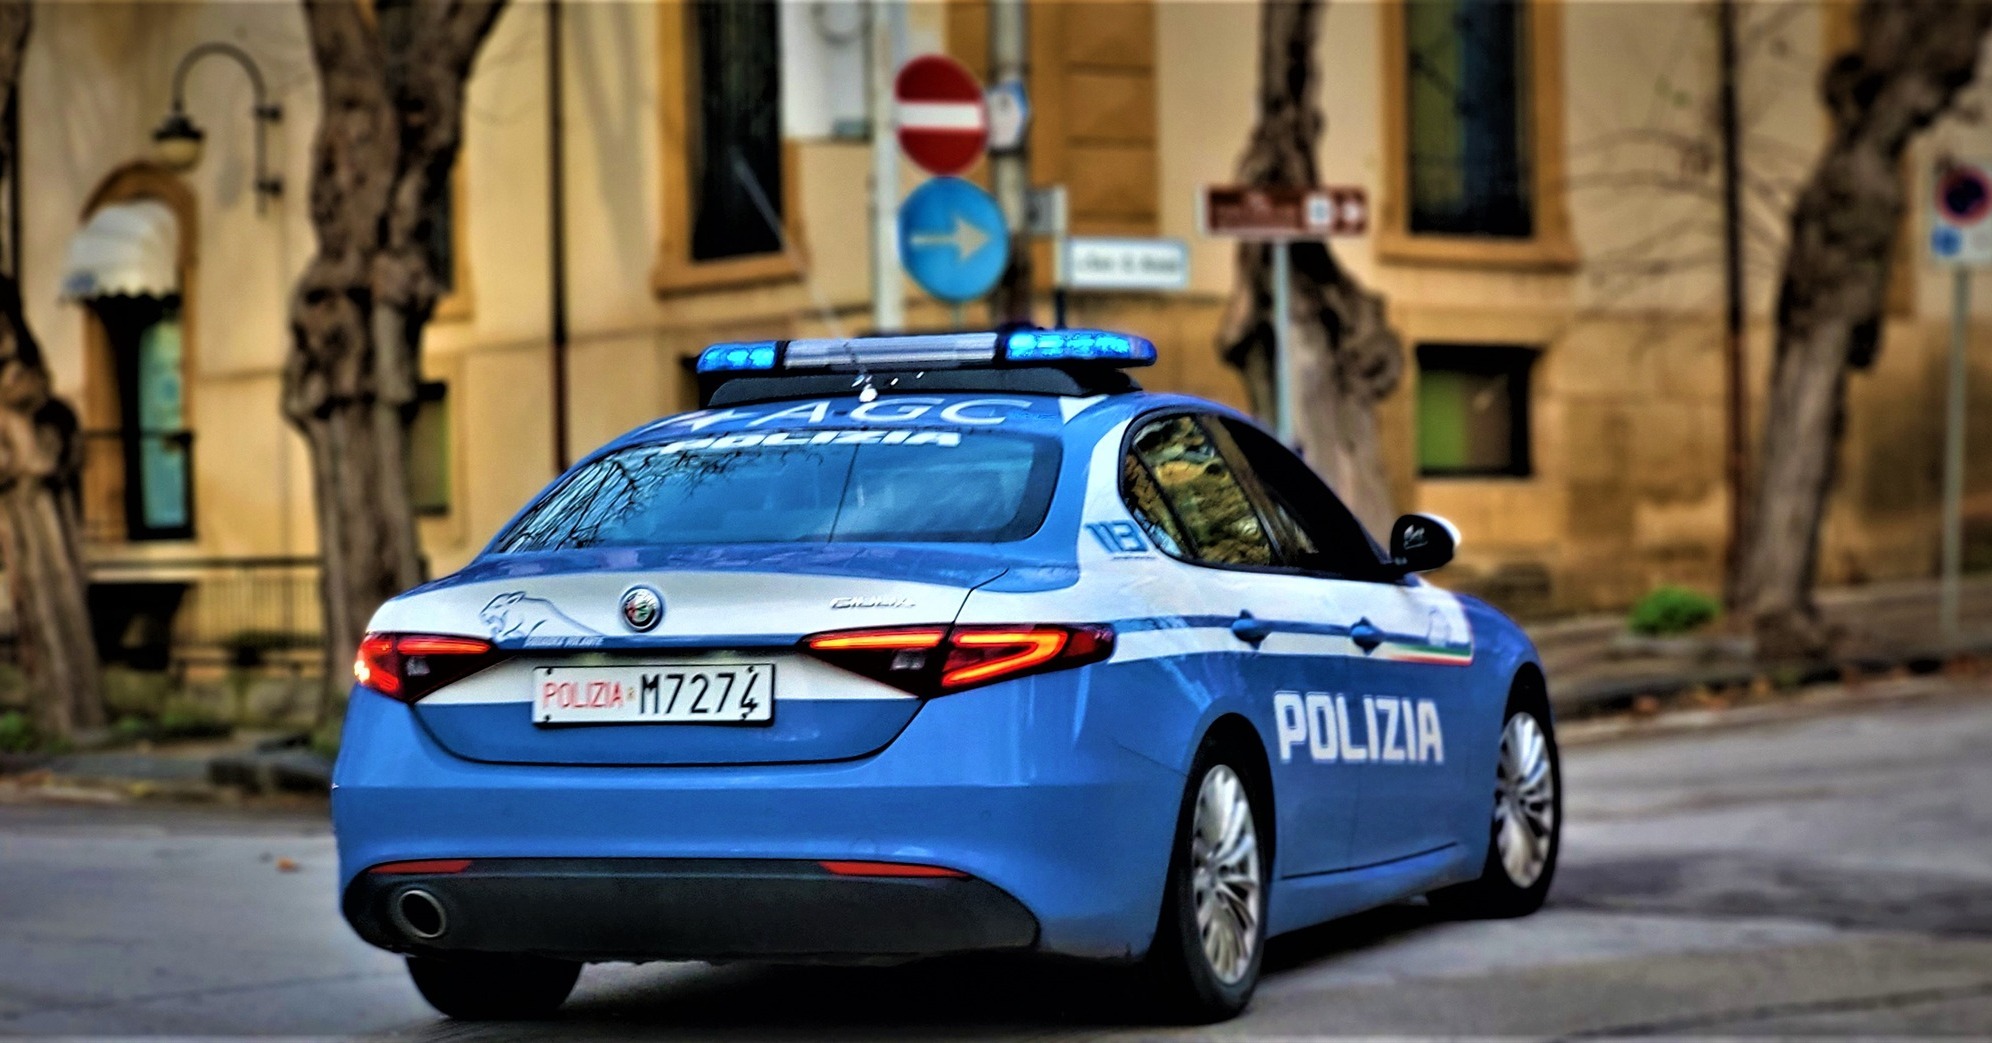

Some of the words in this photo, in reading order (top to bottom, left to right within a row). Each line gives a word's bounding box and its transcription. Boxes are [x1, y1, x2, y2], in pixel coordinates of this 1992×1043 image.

[660, 430, 961, 454] POLIZIA
[1084, 521, 1148, 553] 113
[542, 681, 624, 710] POLIZIA
[639, 672, 760, 715] M7274
[1273, 690, 1445, 765] POLIZIA
